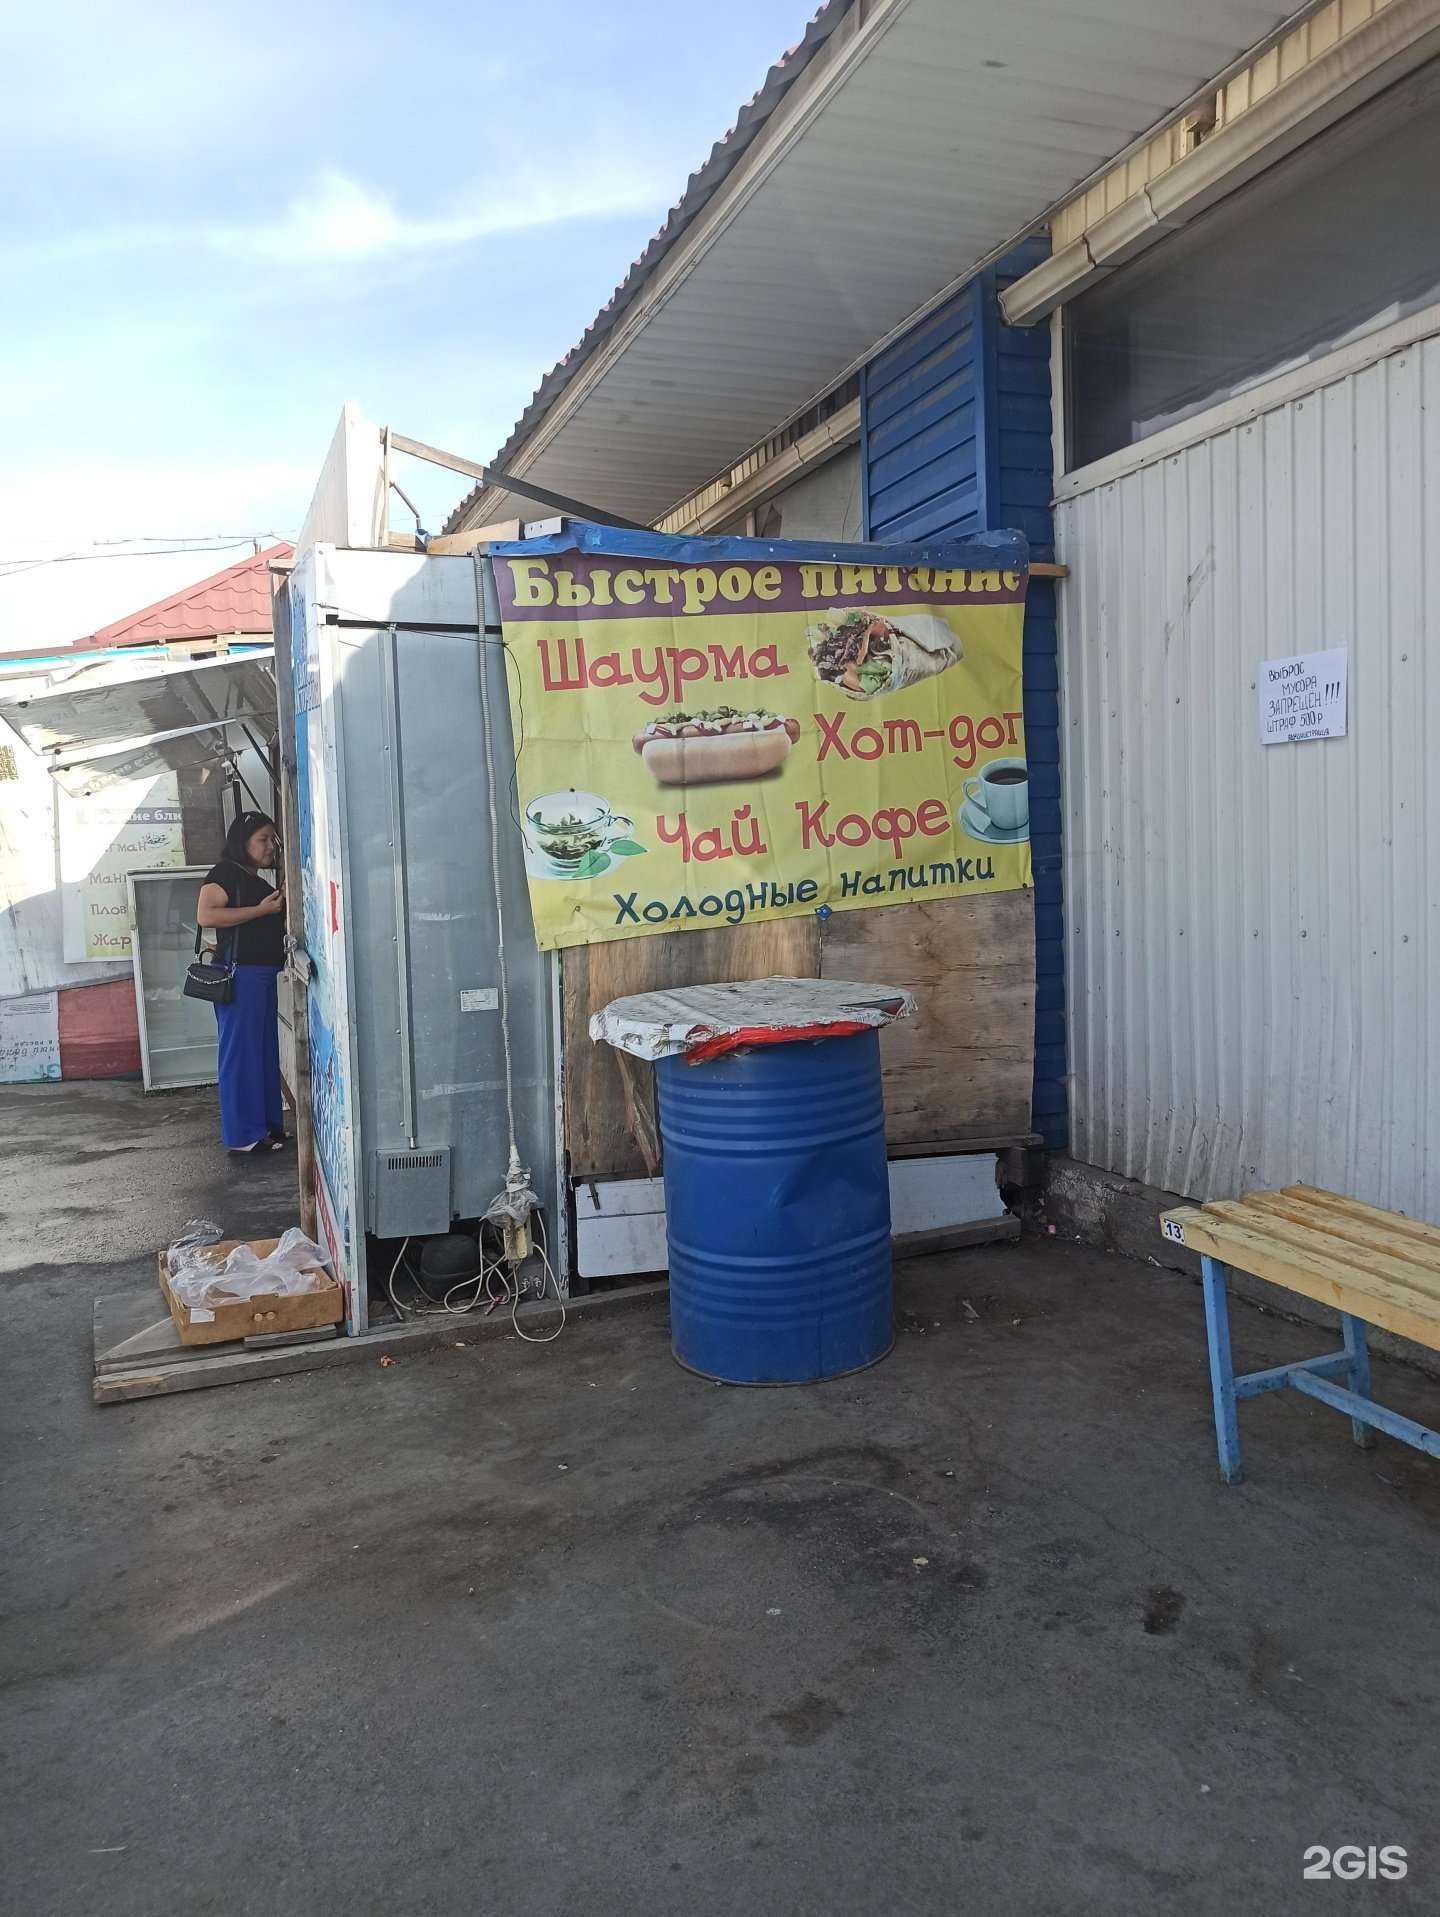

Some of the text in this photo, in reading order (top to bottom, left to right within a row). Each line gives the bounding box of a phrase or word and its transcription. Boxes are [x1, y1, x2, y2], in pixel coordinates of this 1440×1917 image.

[507, 559, 782, 613] Быстрое
[537, 638, 789, 706] Шаурма
[1269, 662, 1305, 682] ВЫБРОС
[1282, 676, 1317, 695] МУСОРА
[814, 712, 1023, 769] Хот-дог
[1267, 716, 1297, 733] ШТРАФ
[656, 799, 951, 863] Чай Кофе
[613, 857, 995, 924] Холодные напитки
[1166, 1222, 1181, 1239] 13
